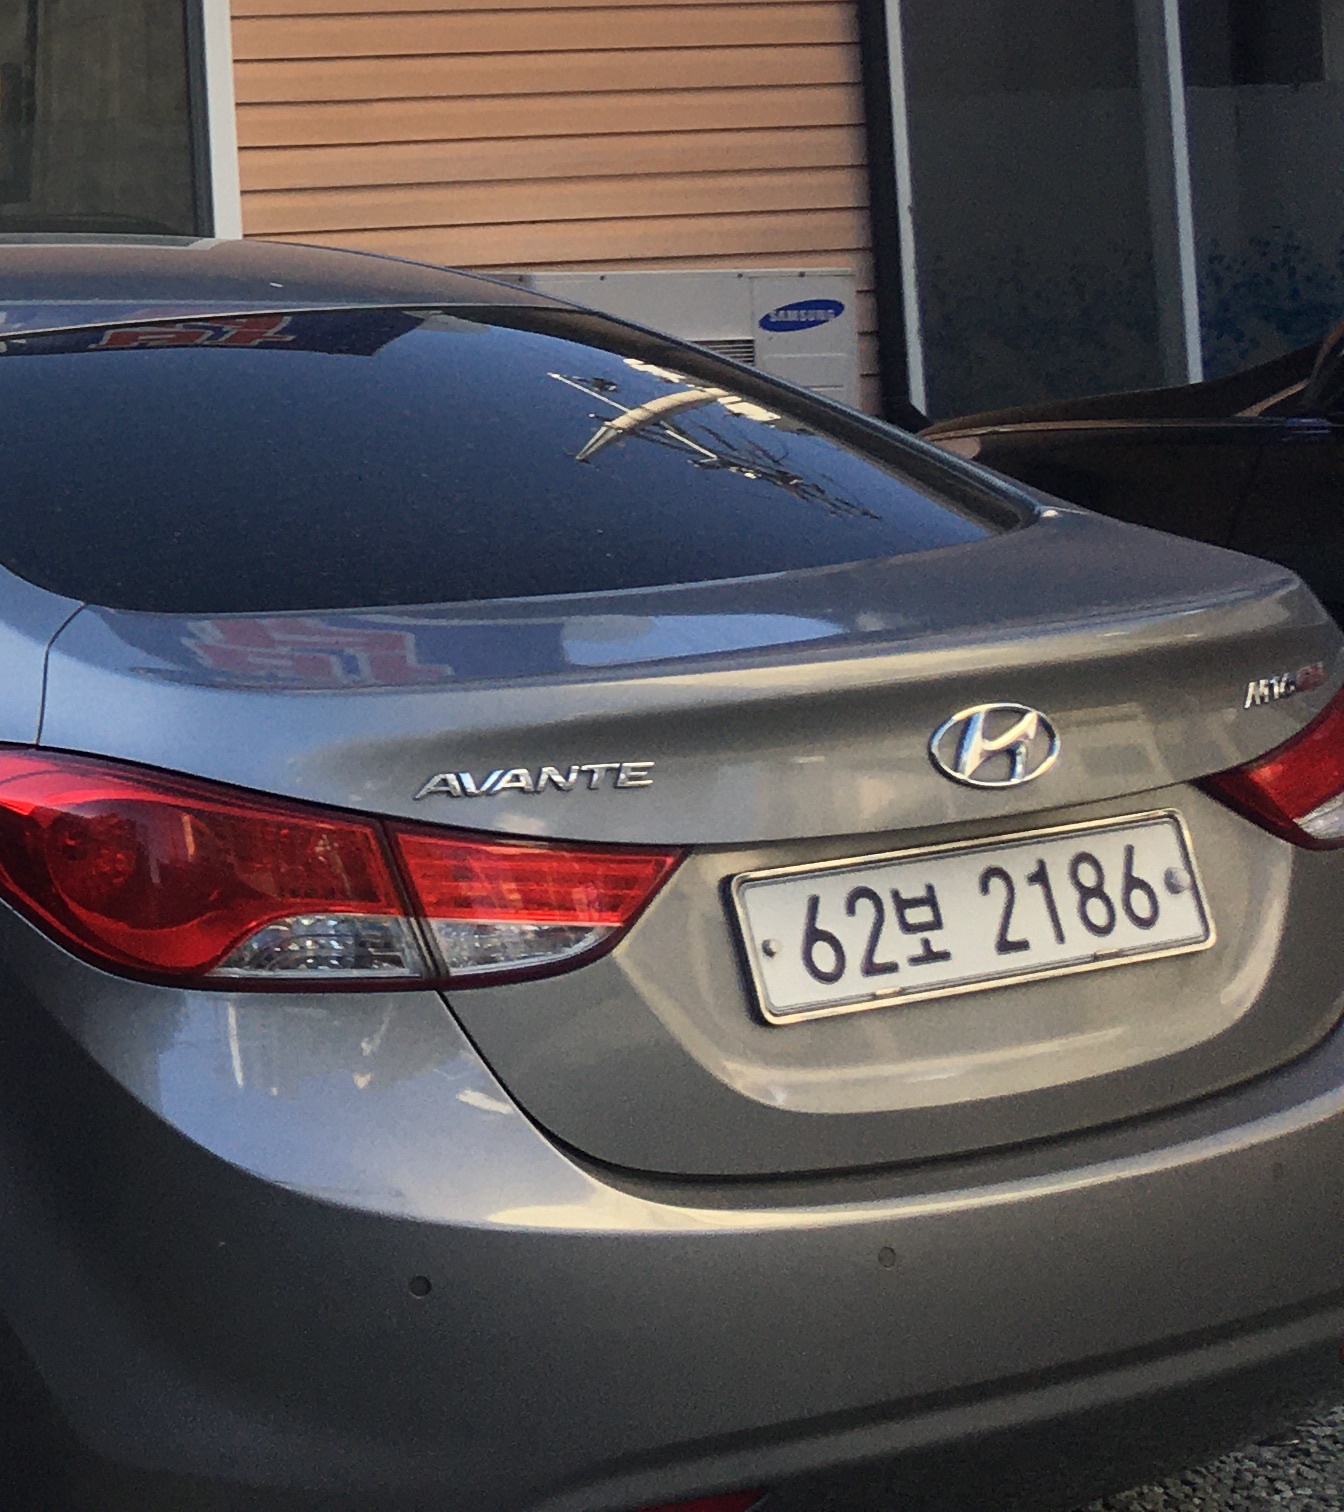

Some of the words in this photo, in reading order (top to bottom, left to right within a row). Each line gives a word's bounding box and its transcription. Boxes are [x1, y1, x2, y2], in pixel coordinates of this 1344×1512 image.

[769, 309, 835, 322] SAMSUNG
[412, 761, 655, 801] AVANTE
[801, 882, 952, 985] 62보
[978, 843, 1160, 956] 2186
